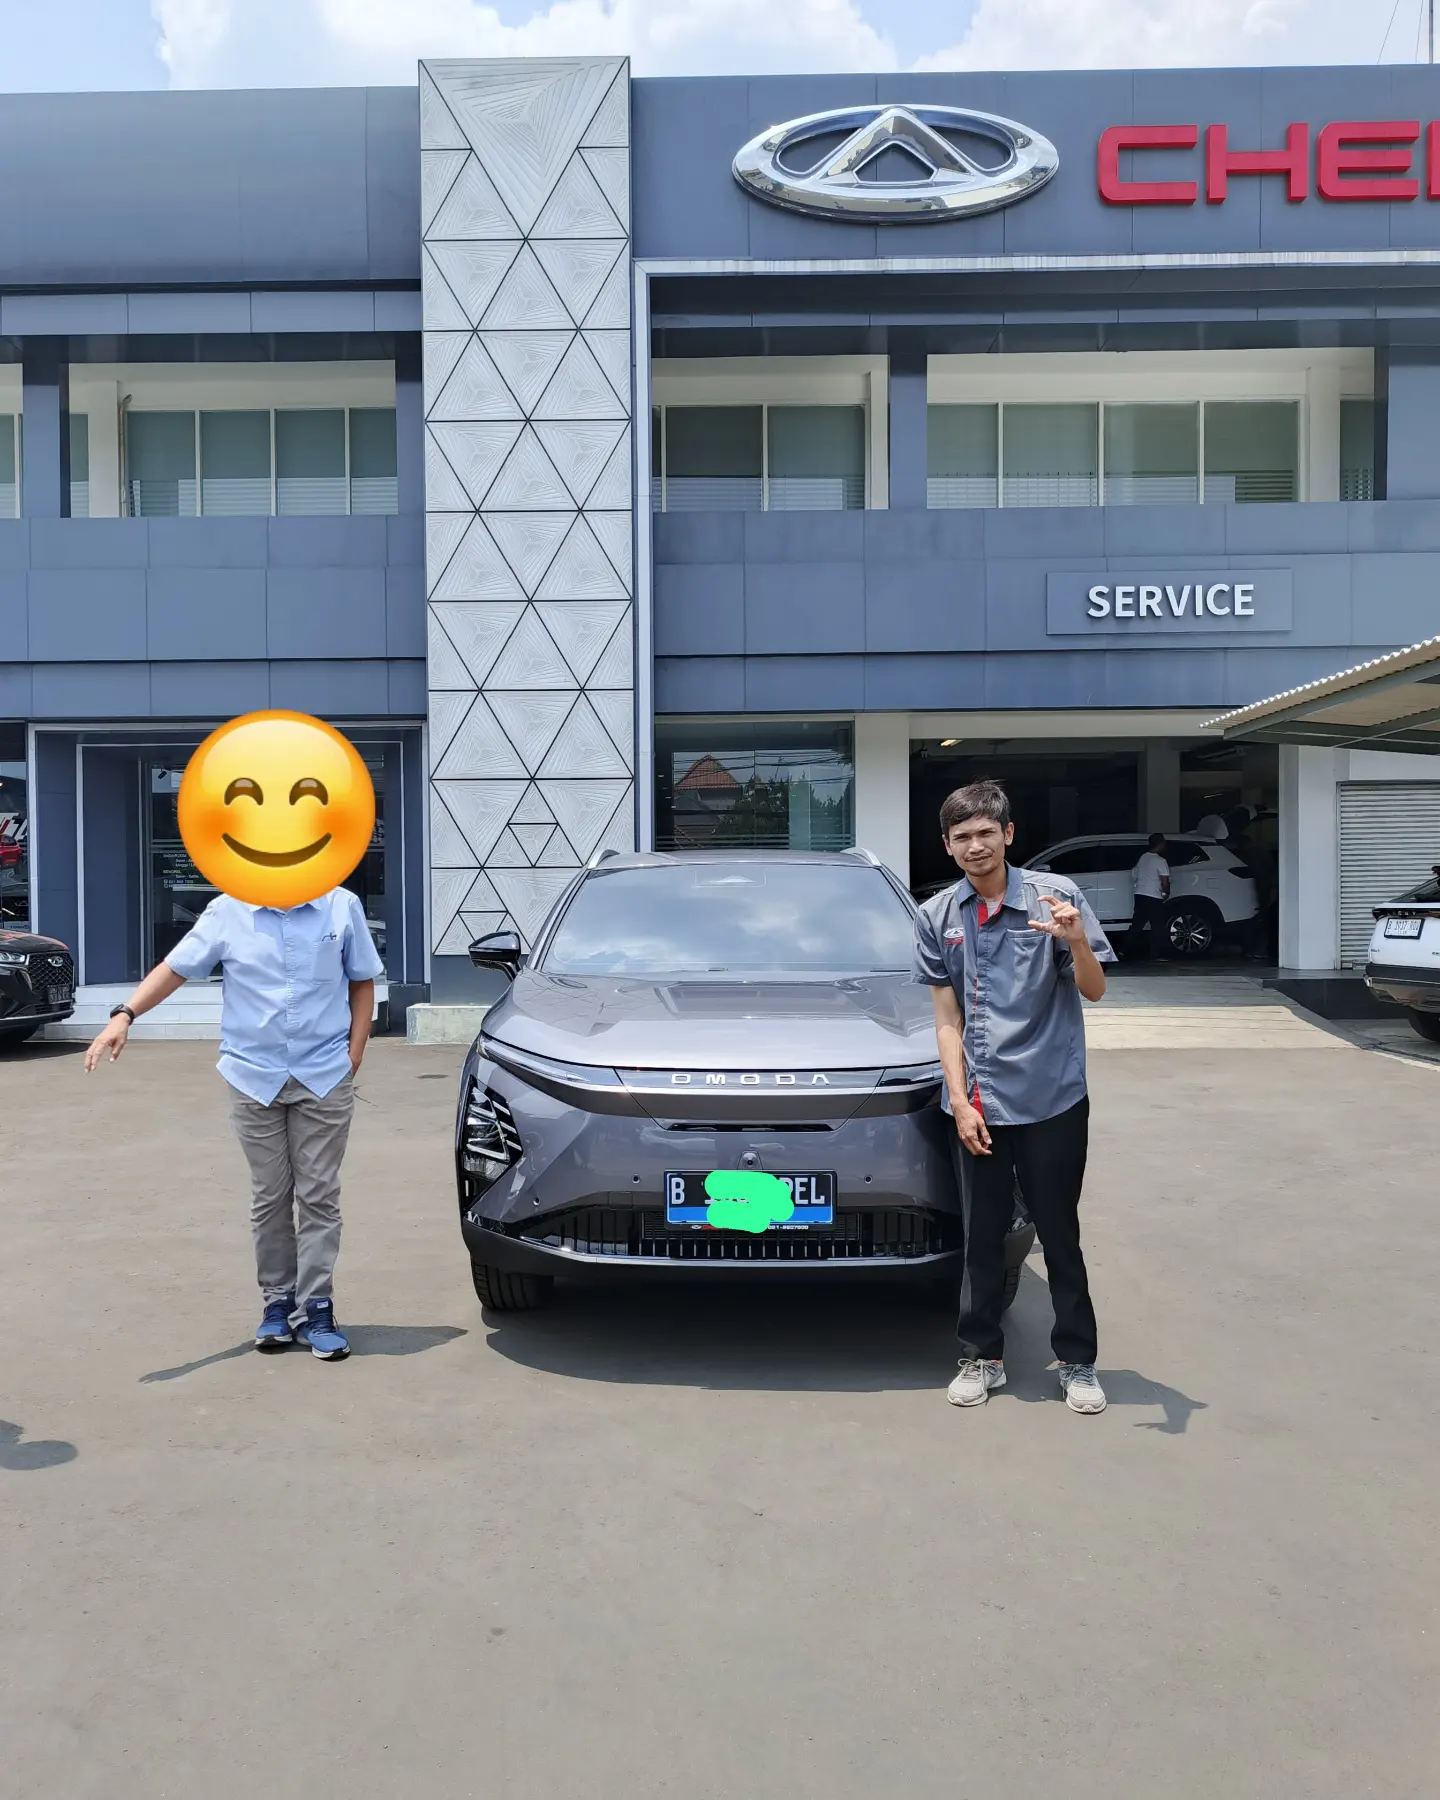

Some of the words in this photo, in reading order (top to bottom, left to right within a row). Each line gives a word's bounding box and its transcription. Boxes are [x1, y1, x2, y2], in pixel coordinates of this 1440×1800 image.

[1098, 120, 1440, 205] CHE
[1087, 583, 1255, 619] SERVICE
[671, 1073, 830, 1086] OMODA
[671, 1177, 685, 1205] B
